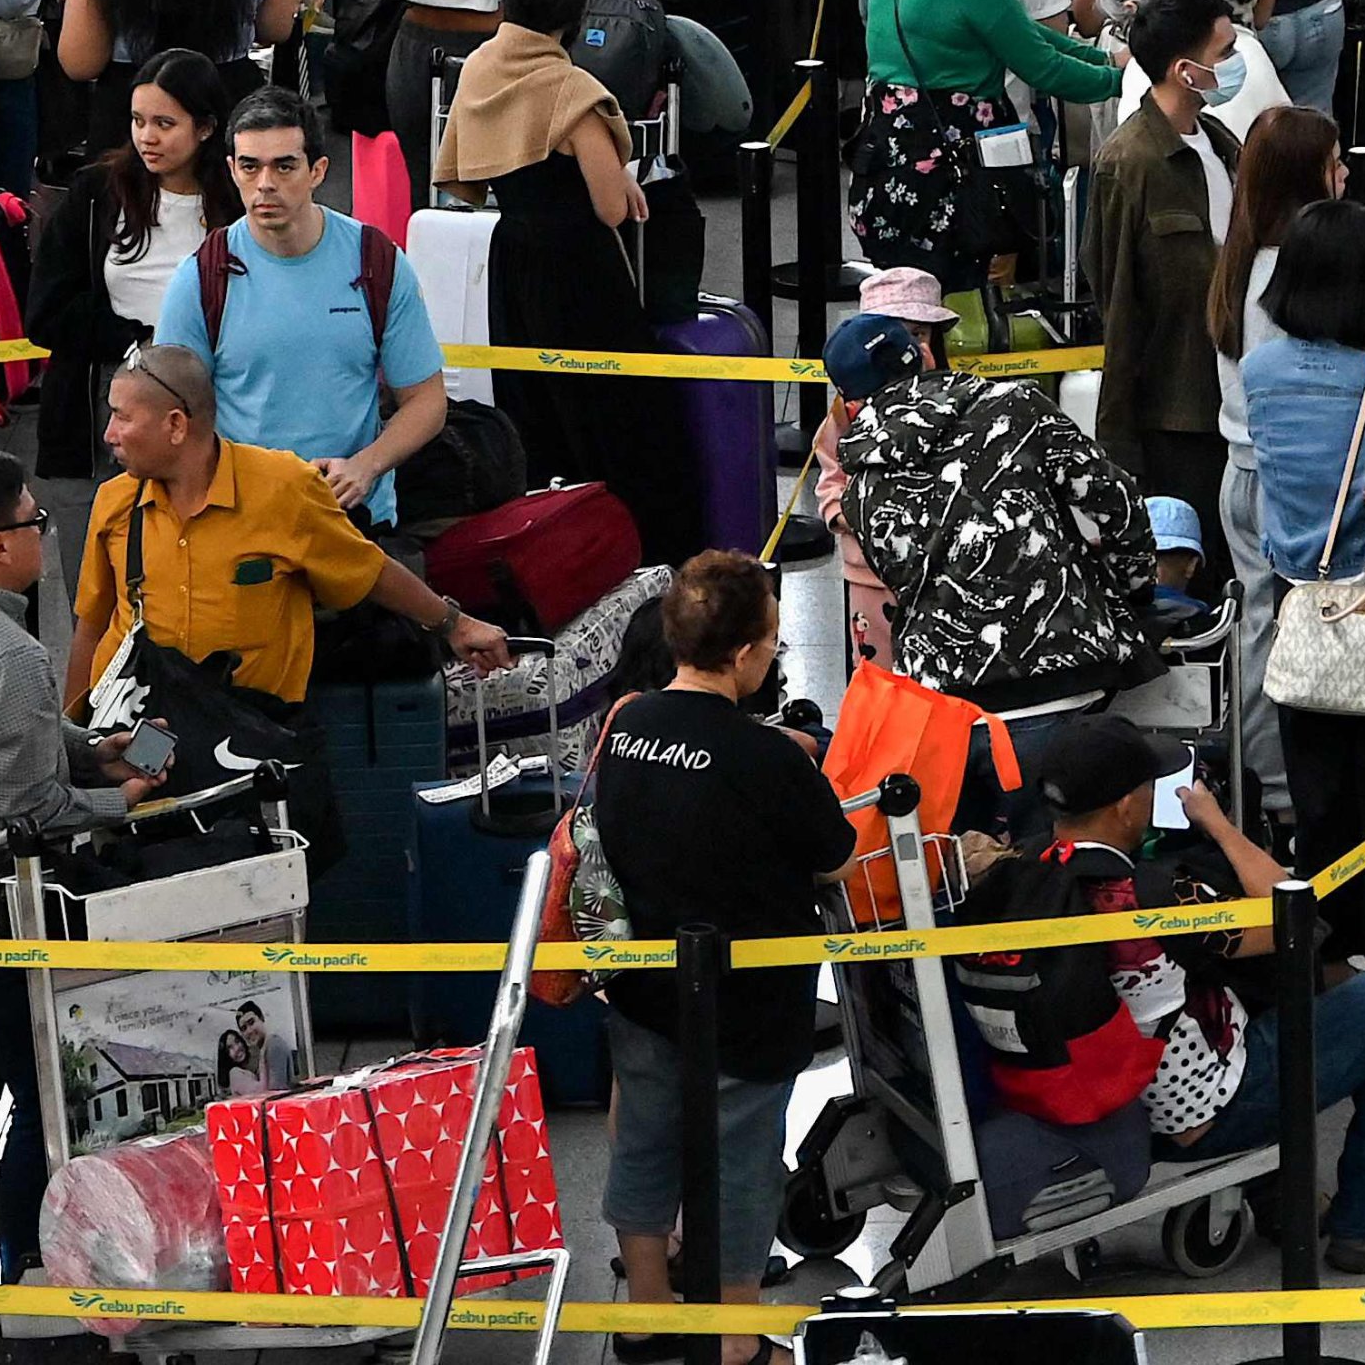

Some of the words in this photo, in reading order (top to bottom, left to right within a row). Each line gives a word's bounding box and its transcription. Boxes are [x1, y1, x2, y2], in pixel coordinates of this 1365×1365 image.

[559, 358, 586, 371] cebu
[587, 359, 622, 373] pacific
[978, 360, 1003, 373] cebu
[1004, 358, 1039, 372] pacific
[610, 732, 712, 771] THAILAND
[1159, 916, 1191, 932] cebu
[1192, 910, 1237, 931] pacific
[4, 948, 50, 965] pacific
[609, 949, 641, 964] cebu
[849, 942, 882, 957] cebu
[883, 939, 927, 958] pacific
[289, 952, 322, 967] cebu
[323, 952, 368, 969] pacific
[99, 1298, 134, 1313] cebu
[136, 1300, 186, 1316] pacific
[450, 1310, 485, 1325] cebu
[487, 1311, 538, 1328] pacific
